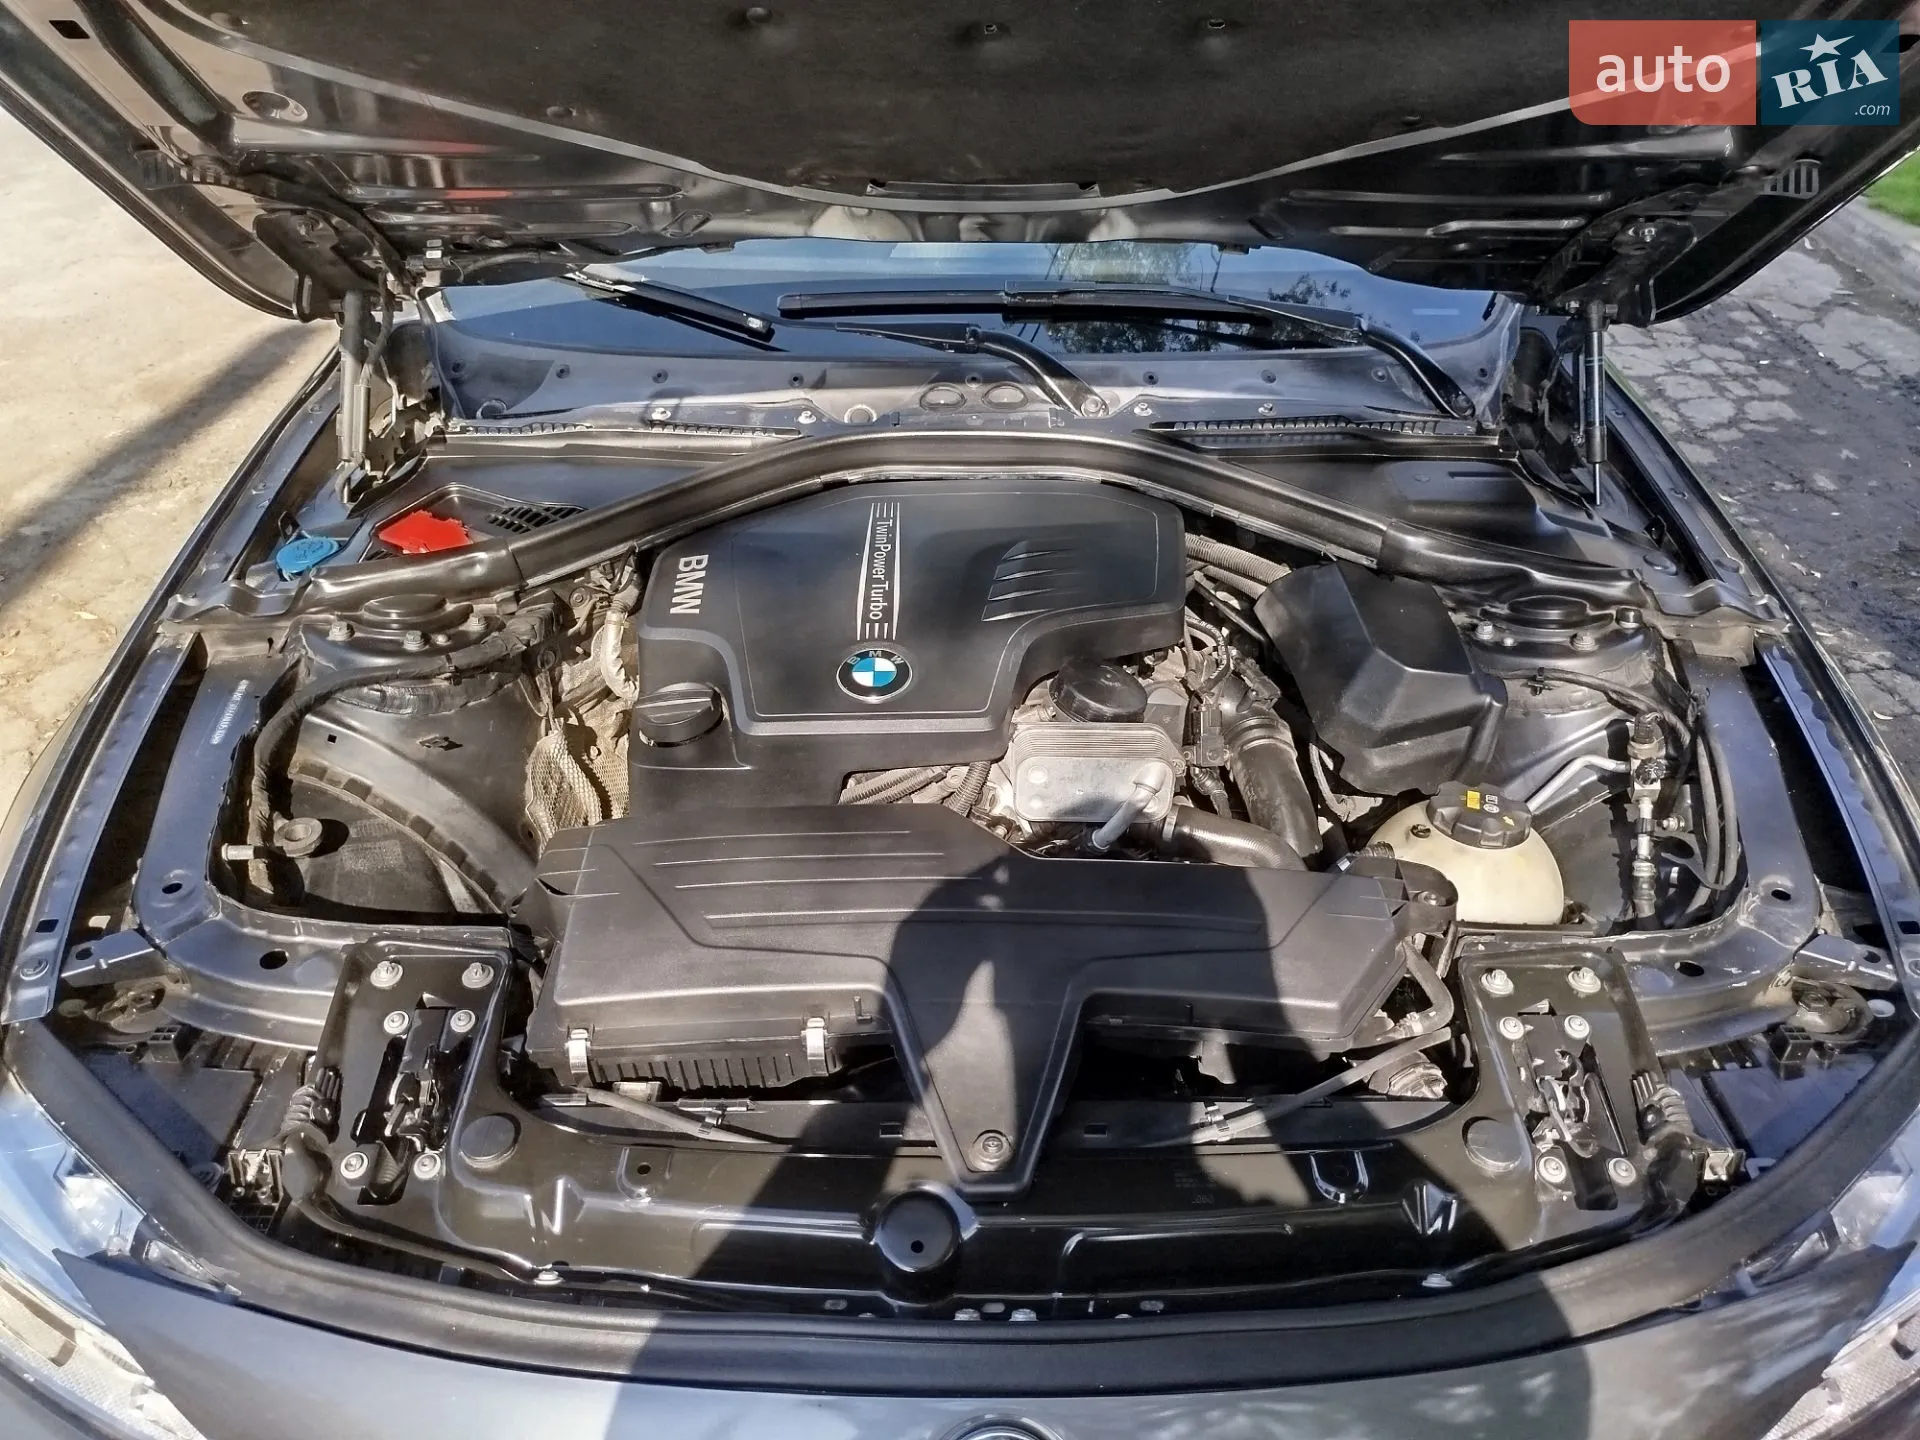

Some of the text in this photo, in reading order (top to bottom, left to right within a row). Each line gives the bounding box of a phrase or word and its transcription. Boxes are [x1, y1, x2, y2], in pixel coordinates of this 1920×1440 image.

[669, 554, 709, 614] BMW
[869, 519, 893, 620] TwinPower Turbo
[846, 650, 904, 666] BMW
